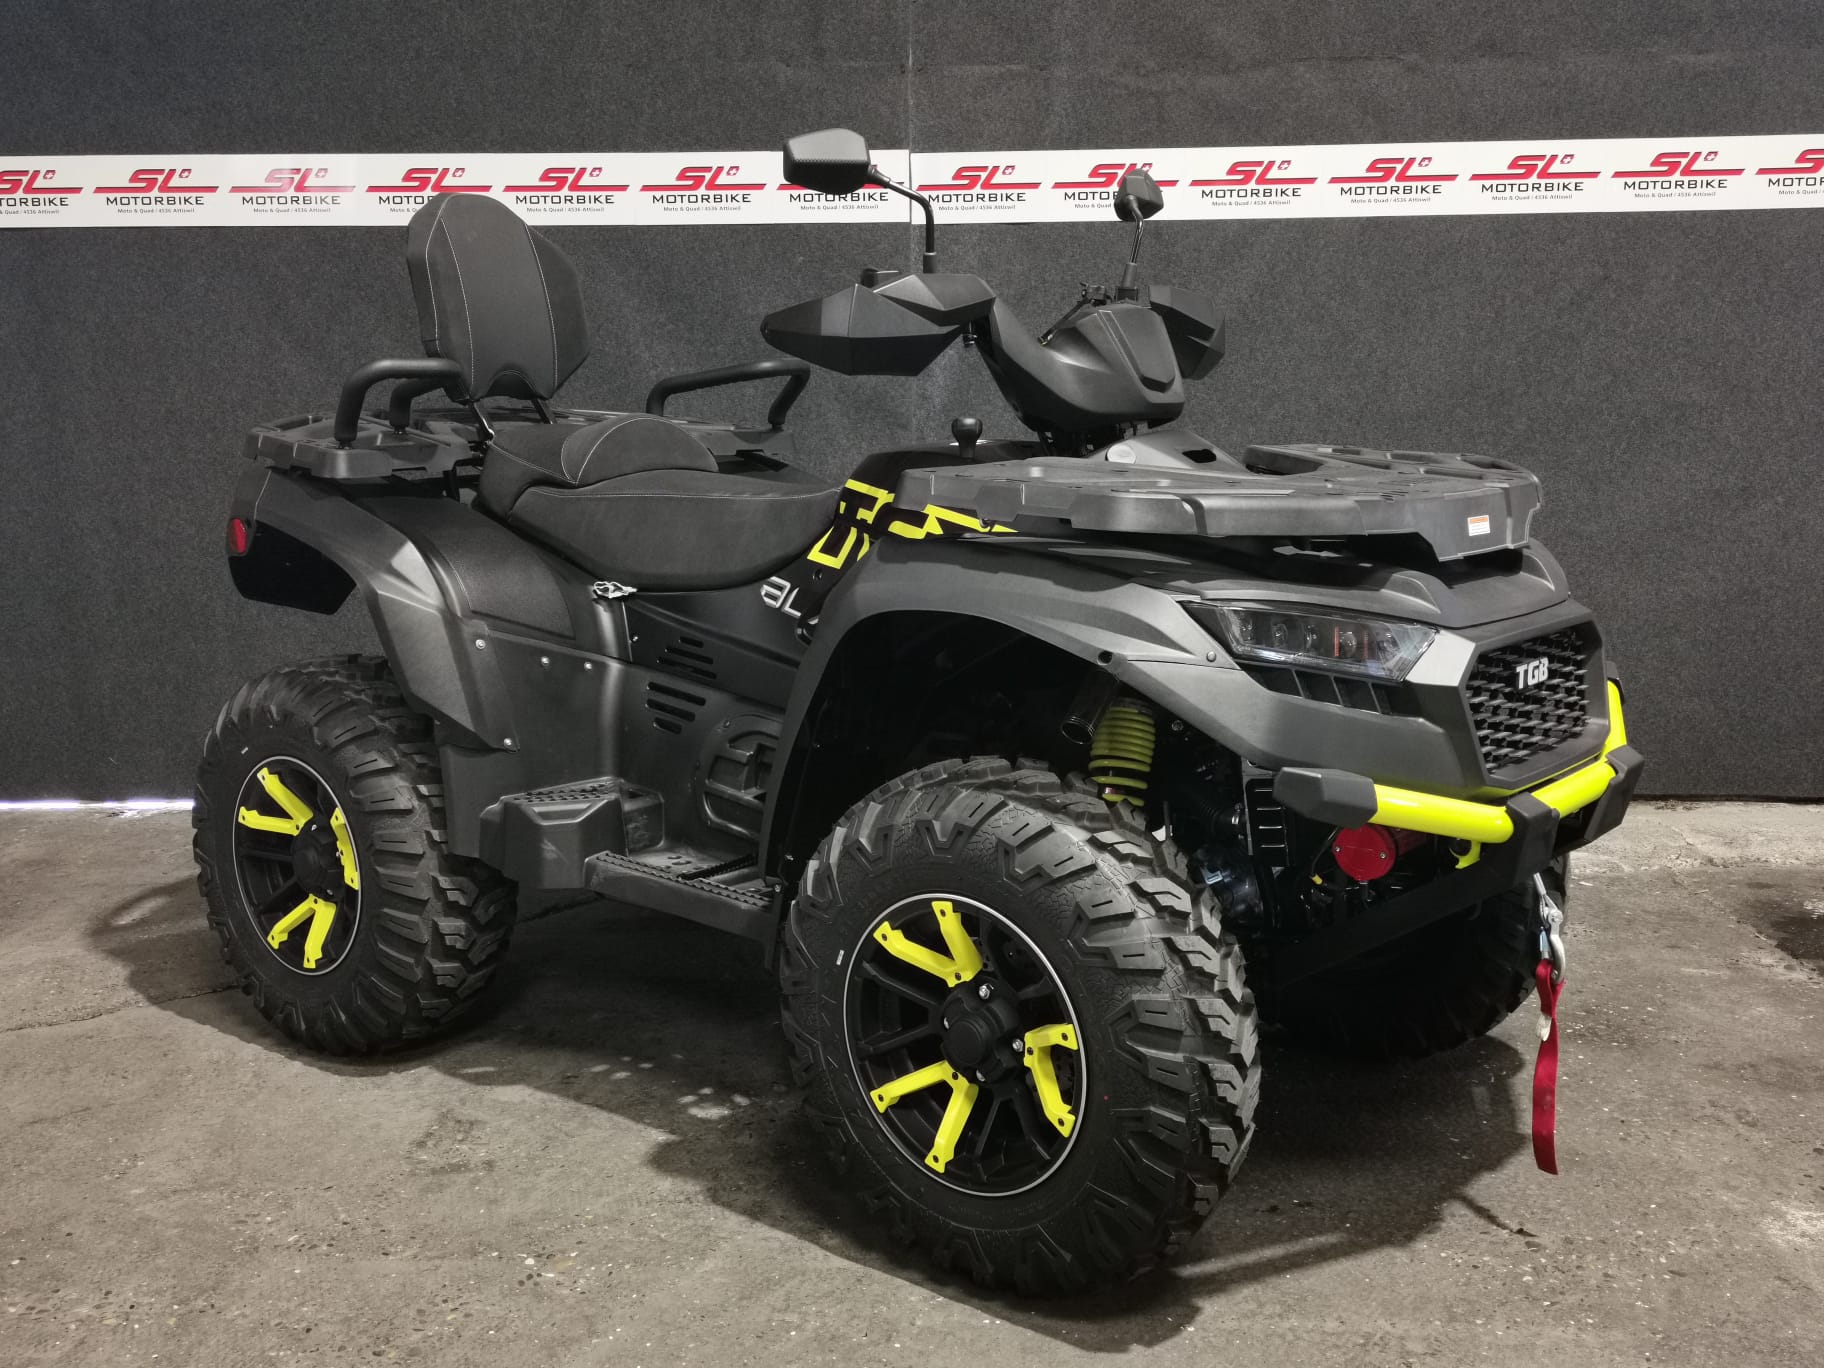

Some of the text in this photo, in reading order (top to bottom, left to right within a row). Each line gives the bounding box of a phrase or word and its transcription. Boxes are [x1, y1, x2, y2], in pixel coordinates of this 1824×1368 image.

[1340, 184, 1442, 196] MOTORBIKE
[1481, 181, 1584, 193] MOTORBIKE
[1624, 179, 1728, 191] MOTORBIKE
[652, 193, 752, 203] MOTORBIKE
[790, 192, 888, 202] MOTORBIKE
[928, 192, 1026, 203] MOTORBIKE
[1201, 187, 1302, 199] MOTORBIKE
[0, 197, 69, 207] TORBIKE
[106, 196, 204, 206] MOTORBIKE
[242, 195, 341, 205] MOTORBIKE
[515, 194, 614, 204] MOTORBIKE
[760, 576, 802, 619] BL
[1516, 657, 1549, 689] TGB
